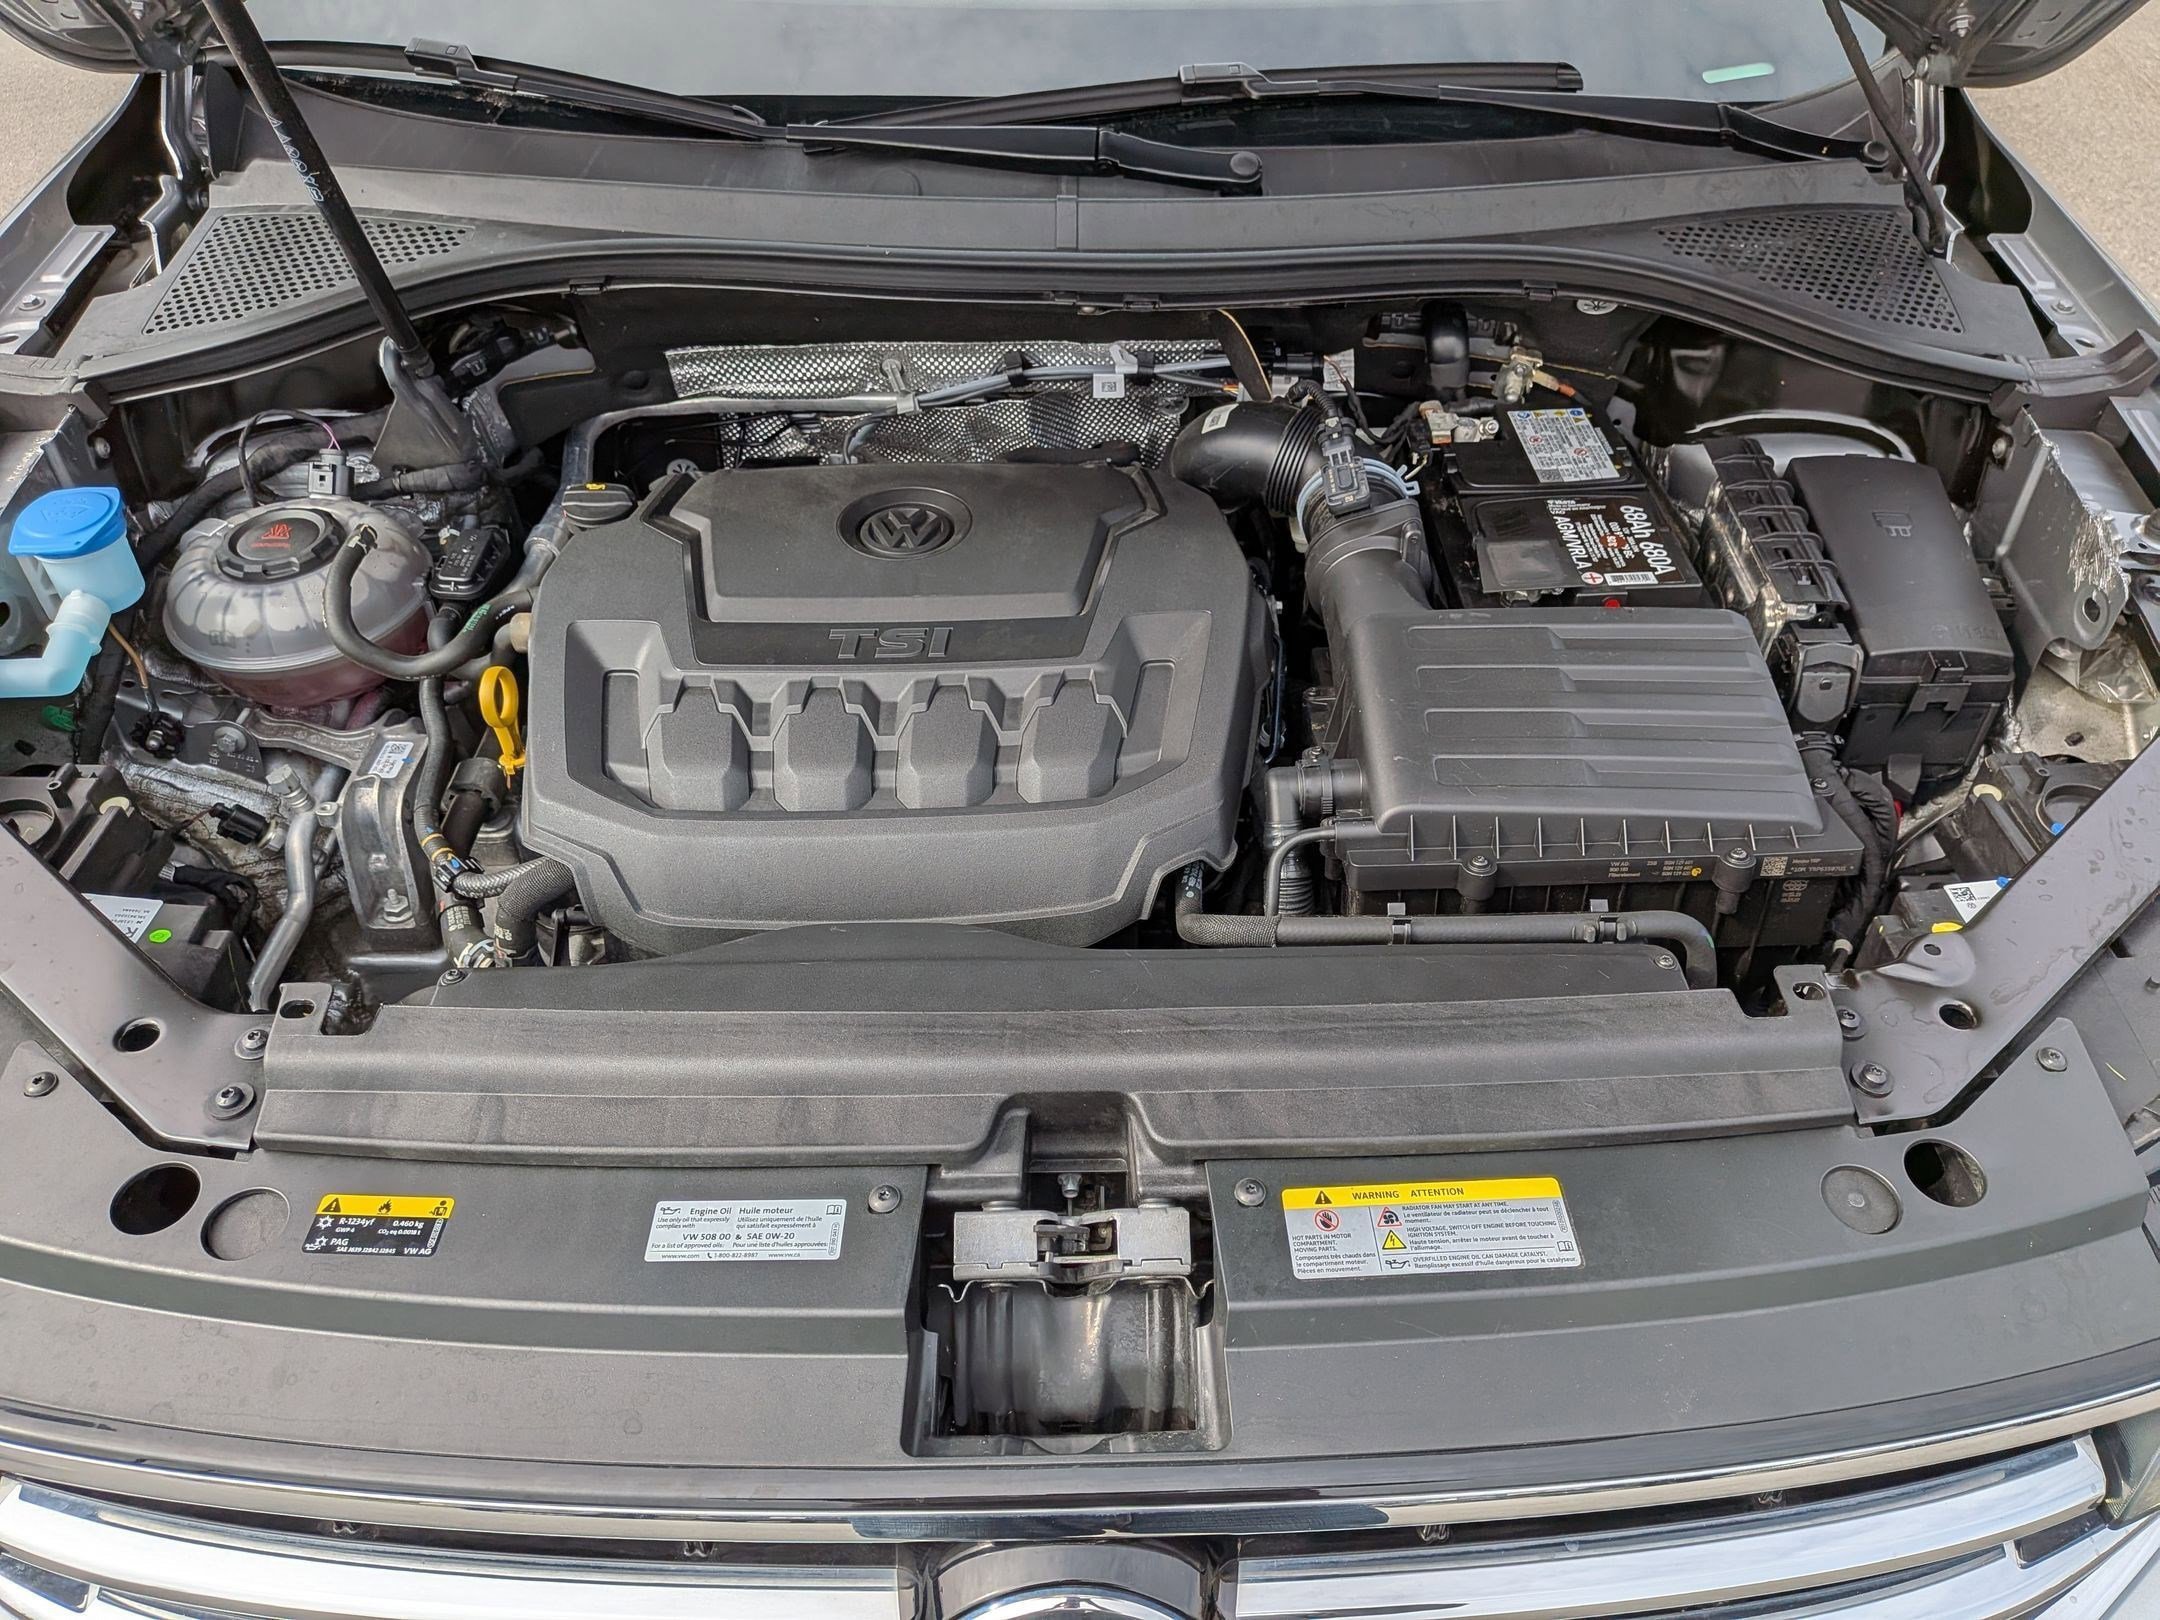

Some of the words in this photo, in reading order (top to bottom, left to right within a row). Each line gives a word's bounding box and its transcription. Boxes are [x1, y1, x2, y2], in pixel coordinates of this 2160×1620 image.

[1620, 505, 1652, 538] 68Ah
[1639, 541, 1676, 575] 680A
[829, 627, 953, 659] TSI
[1352, 1191, 1400, 1200] WARNING
[1410, 1187, 1464, 1197] ATTENTION
[690, 1208, 718, 1216] Engine
[339, 1218, 376, 1228] R-1234yf
[414, 1220, 424, 1229] kg
[1303, 1260, 1344, 1268] compartiment
